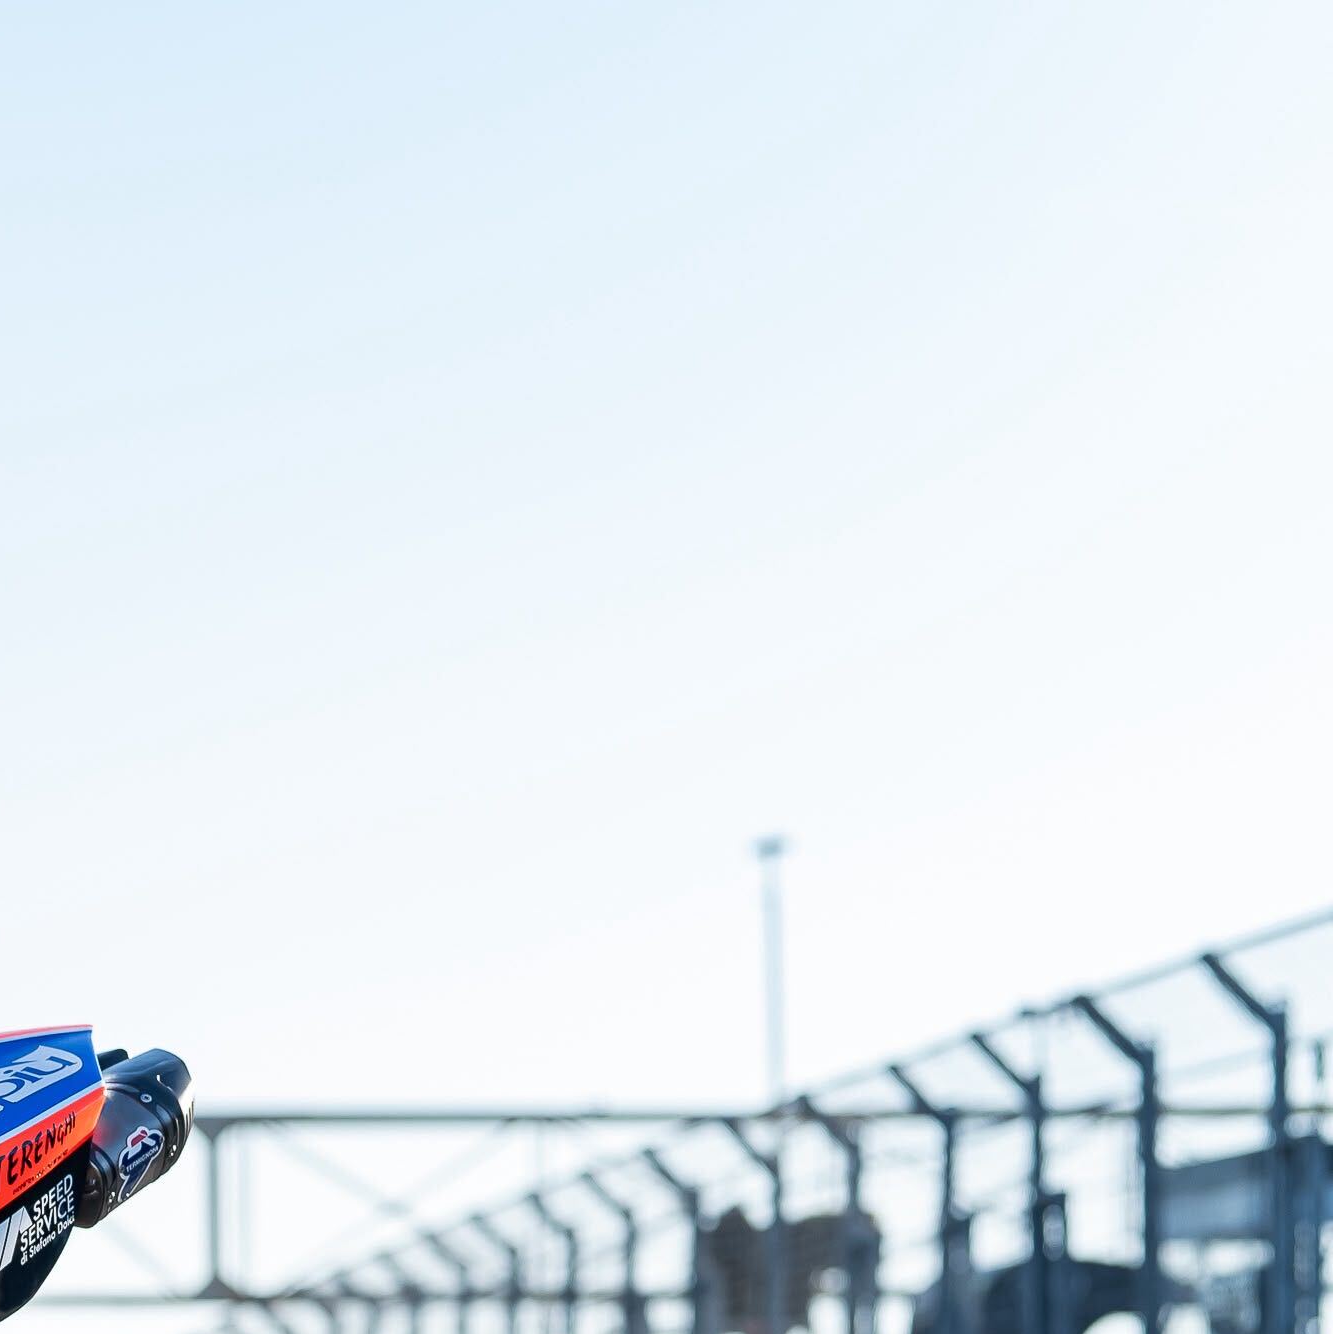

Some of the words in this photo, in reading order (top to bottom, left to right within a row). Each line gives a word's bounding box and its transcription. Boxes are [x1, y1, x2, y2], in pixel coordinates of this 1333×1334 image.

[33, 1174, 73, 1220] SPEED
[20, 1192, 75, 1252] SERVICE
[29, 1231, 56, 1258] Stefano
